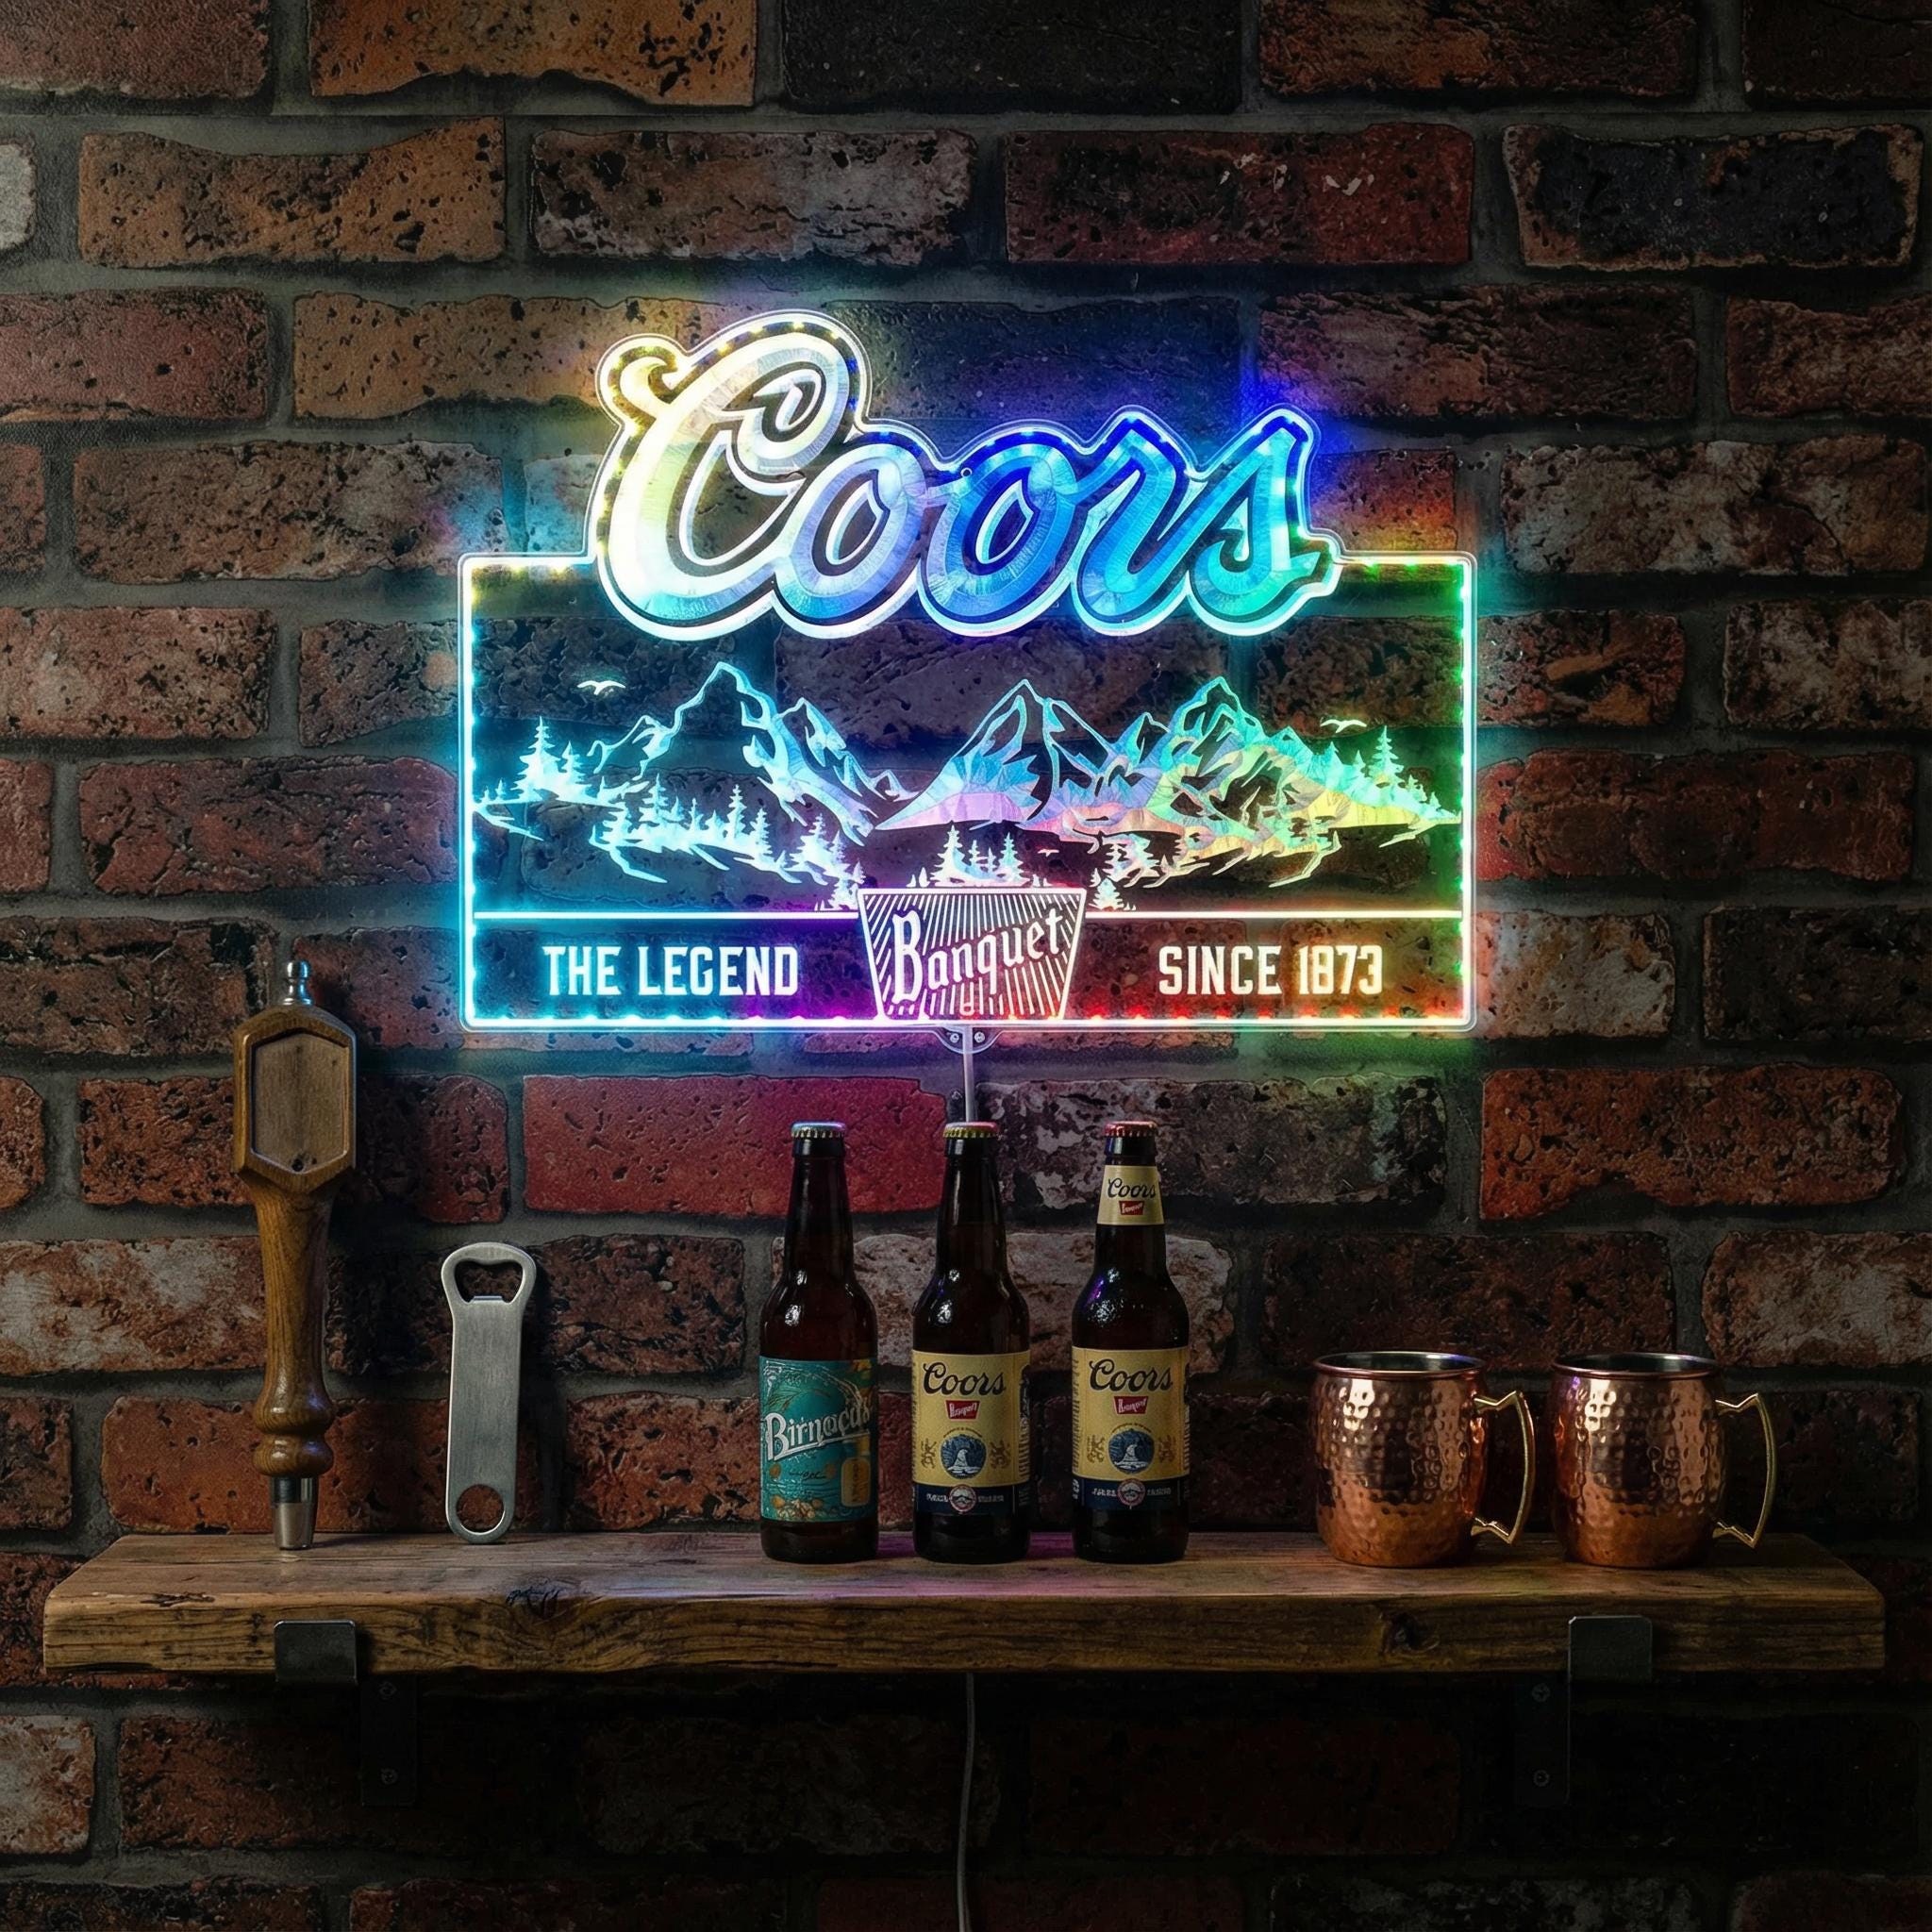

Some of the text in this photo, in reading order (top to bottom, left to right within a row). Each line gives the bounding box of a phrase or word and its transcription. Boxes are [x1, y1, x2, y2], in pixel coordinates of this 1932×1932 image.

[591, 313, 1341, 639] Coors
[541, 945, 799, 996] THE LEGEND
[891, 908, 1064, 1004] Banquet
[1158, 944, 1383, 995] SINCE 1873
[1108, 1176, 1157, 1199] Coors
[922, 1361, 1007, 1396] Coors
[1089, 1357, 1174, 1393] Coors
